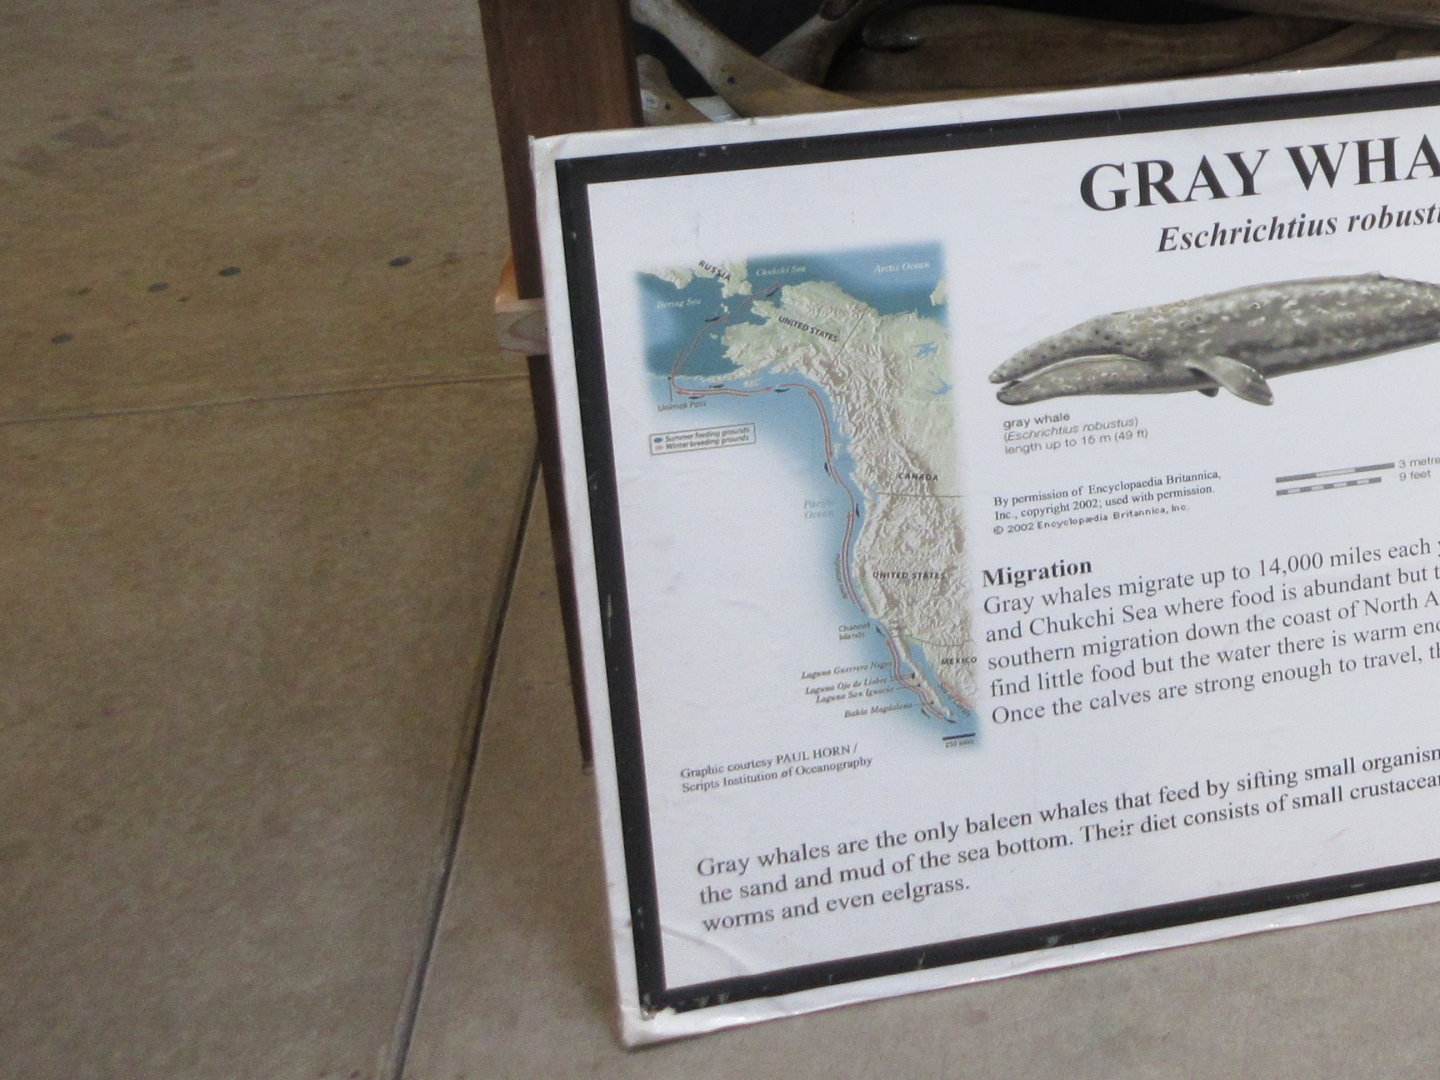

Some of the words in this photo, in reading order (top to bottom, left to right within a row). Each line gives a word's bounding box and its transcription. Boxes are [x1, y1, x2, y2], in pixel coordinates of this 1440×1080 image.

[1080, 149, 1270, 211] GRAY
[1156, 213, 1337, 253] Eschrichtius
[699, 260, 731, 281] RUSSIA
[778, 316, 809, 333] UNITED
[809, 326, 840, 342] STATES
[1003, 419, 1030, 431] gray
[1034, 413, 1070, 424] whale
[1004, 426, 1079, 443] (Eschrichtius
[1083, 417, 1138, 431] robustus)
[1005, 443, 1042, 454] length
[1046, 441, 1061, 451] up
[1065, 439, 1077, 447] to
[1115, 430, 1133, 442] (49
[1137, 429, 1148, 439] ft)
[1399, 460, 1406, 468] 3
[1399, 472, 1406, 481] 9
[1410, 470, 1430, 479] feet
[898, 473, 939, 482] CANADA
[994, 496, 1008, 508] By
[1012, 489, 1068, 507] permission
[1071, 486, 1084, 496] of
[1089, 477, 1163, 494] Encyclopaedia
[1166, 470, 1222, 484] Britannica,
[995, 511, 1017, 520] Inc.,
[1021, 503, 1070, 518] copyright
[1105, 494, 1128, 506] used
[1132, 491, 1154, 503] with
[1157, 485, 1215, 502] permission.
[873, 571, 908, 579] UNITED
[912, 572, 947, 580] STATES
[982, 559, 1092, 588] Migration
[984, 596, 1034, 615] Gray
[1042, 583, 1111, 606] whales
[1118, 573, 1194, 597] migrate
[1201, 571, 1225, 588] up
[1232, 566, 1250, 580] to
[1260, 552, 1323, 576] 14,000
[1330, 546, 1381, 567] miles
[1388, 538, 1431, 559] each
[941, 656, 977, 665] MEXICO
[680, 765, 724, 778] Graphic
[727, 759, 773, 772] courtesy
[776, 751, 810, 764] PAUL
[813, 745, 850, 759] HORN
[682, 781, 720, 792] Scripts
[723, 772, 778, 786] Institution
[781, 766, 793, 778] of
[795, 757, 872, 775] Oceanography
[702, 909, 774, 932] worms
[782, 896, 820, 920] and
[826, 893, 875, 912] even
[882, 879, 970, 904] eelgrass.
